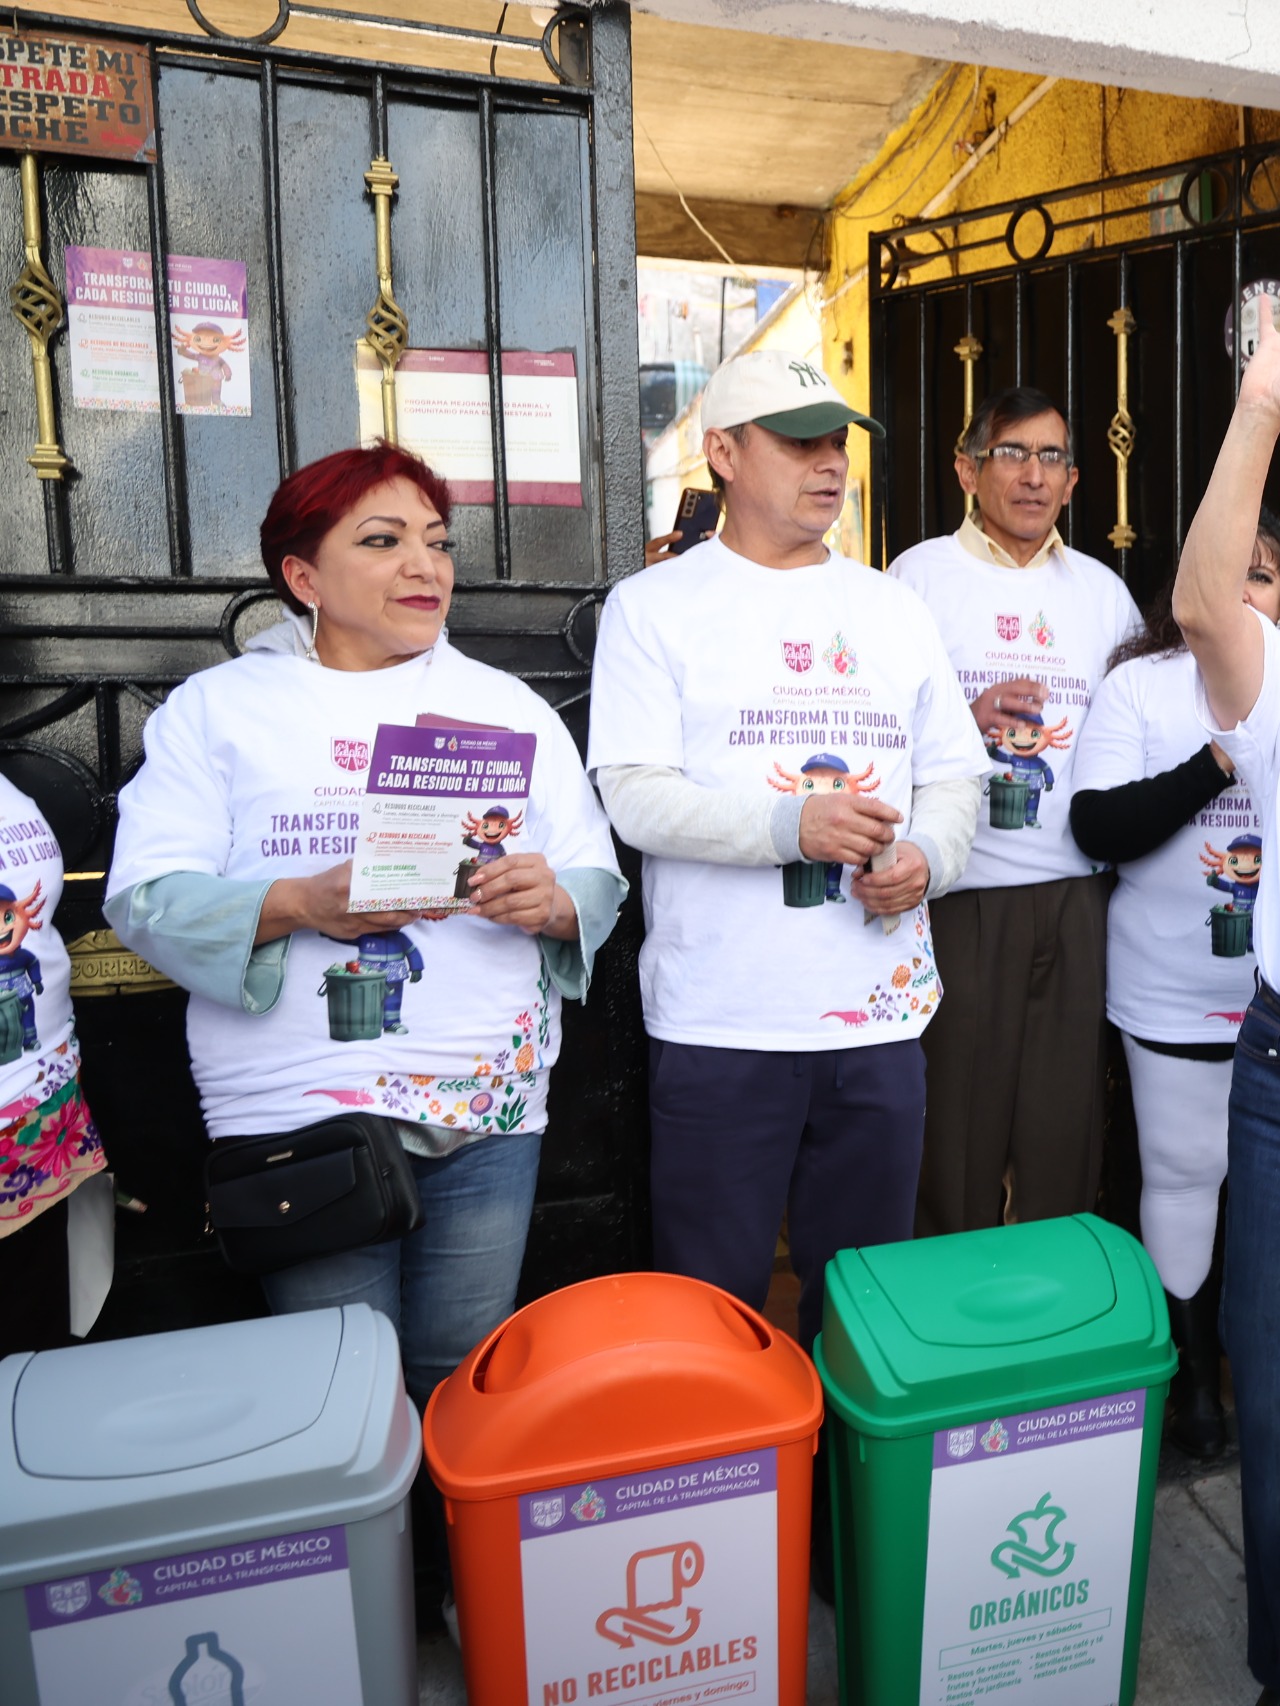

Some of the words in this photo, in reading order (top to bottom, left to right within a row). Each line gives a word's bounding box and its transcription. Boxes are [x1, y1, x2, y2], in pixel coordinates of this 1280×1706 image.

[0, 37, 87, 69] PETE
[97, 50, 134, 76] MI
[119, 78, 138, 101] Y
[0, 114, 89, 145] CHE
[83, 272, 153, 290] TRANSFORM
[186, 282, 232, 299] CIUDAD,
[76, 287, 107, 301] CADA
[112, 290, 153, 305] RESIDU
[184, 296, 199, 310] SU
[203, 298, 239, 313] LUGAR
[985, 651, 1019, 661] CIUDAD
[1021, 653, 1032, 662] DE
[1034, 654, 1066, 665] MÉXICO
[772, 685, 812, 697] CIUDAD
[815, 686, 829, 696] DE
[832, 685, 871, 697] MÉXICO
[1051, 675, 1090, 694] CIUDAD,
[1049, 691, 1062, 704] SU
[739, 709, 828, 726] TRANSFORMA
[832, 710, 849, 726] TU
[854, 710, 902, 731] CIUDAD,
[729, 730, 765, 745] CADA
[770, 729, 826, 745] RESIDUO
[831, 730, 847, 745] EN
[853, 730, 868, 747] SU
[871, 732, 907, 750] LUGAR
[390, 755, 467, 774] TRANSFORMA
[471, 760, 485, 775] TU
[486, 761, 523, 777] CIUDAD,
[377, 772, 411, 788] CADA
[413, 774, 463, 791] RESIDUO
[465, 777, 478, 792] EN
[481, 778, 495, 792] SU
[497, 778, 526, 792] LUGAR
[271, 812, 360, 834] TRANSFOR
[1200, 813, 1250, 828] RESIDUO
[7, 847, 28, 866] SU
[261, 837, 302, 857] CADA
[309, 836, 357, 855] RESI
[70, 957, 161, 980] CORRE
[1017, 1413, 1066, 1433] CIUDAD
[1069, 1410, 1086, 1422] DE
[1088, 1400, 1136, 1420] MÉXICO
[1016, 1432, 1046, 1446] CAPITAL
[1047, 1430, 1058, 1439] DE
[1058, 1429, 1068, 1437] LA
[1069, 1415, 1136, 1436] TRANSFORMACIÓN
[615, 1477, 674, 1500] CIUDAD
[678, 1474, 698, 1488] DE
[702, 1462, 760, 1485] MÉXICO
[616, 1498, 652, 1513] CAPITAL
[653, 1495, 667, 1505] DE
[667, 1492, 679, 1502] LA
[680, 1478, 760, 1500] TRANSFORMACIÓN
[153, 1555, 227, 1582] CIUDAD
[231, 1550, 257, 1566] DE
[260, 1536, 331, 1561] MÉXICO
[155, 1579, 199, 1596] CAPITAL
[201, 1575, 217, 1587] DE
[218, 1572, 233, 1583] LA
[235, 1553, 333, 1580] TRANSFORMACIÓN
[968, 1578, 1090, 1632] ORGÁNICOS
[970, 1641, 1005, 1656] Martes,
[1006, 1633, 1037, 1648] jueves
[1038, 1630, 1045, 1641] y
[1046, 1621, 1083, 1637] sábados
[1062, 1644, 1071, 1653] de
[1090, 1638, 1095, 1647] y
[1074, 1650, 1088, 1659] con
[542, 1677, 577, 1706] NO
[587, 1635, 758, 1698] RECICLABLES
[976, 1665, 986, 1674] de
[1058, 1664, 1068, 1673] de
[694, 1690, 702, 1702] y
[704, 1678, 750, 1698] domingo
[972, 1679, 977, 1688] y
[974, 1687, 984, 1695] de
